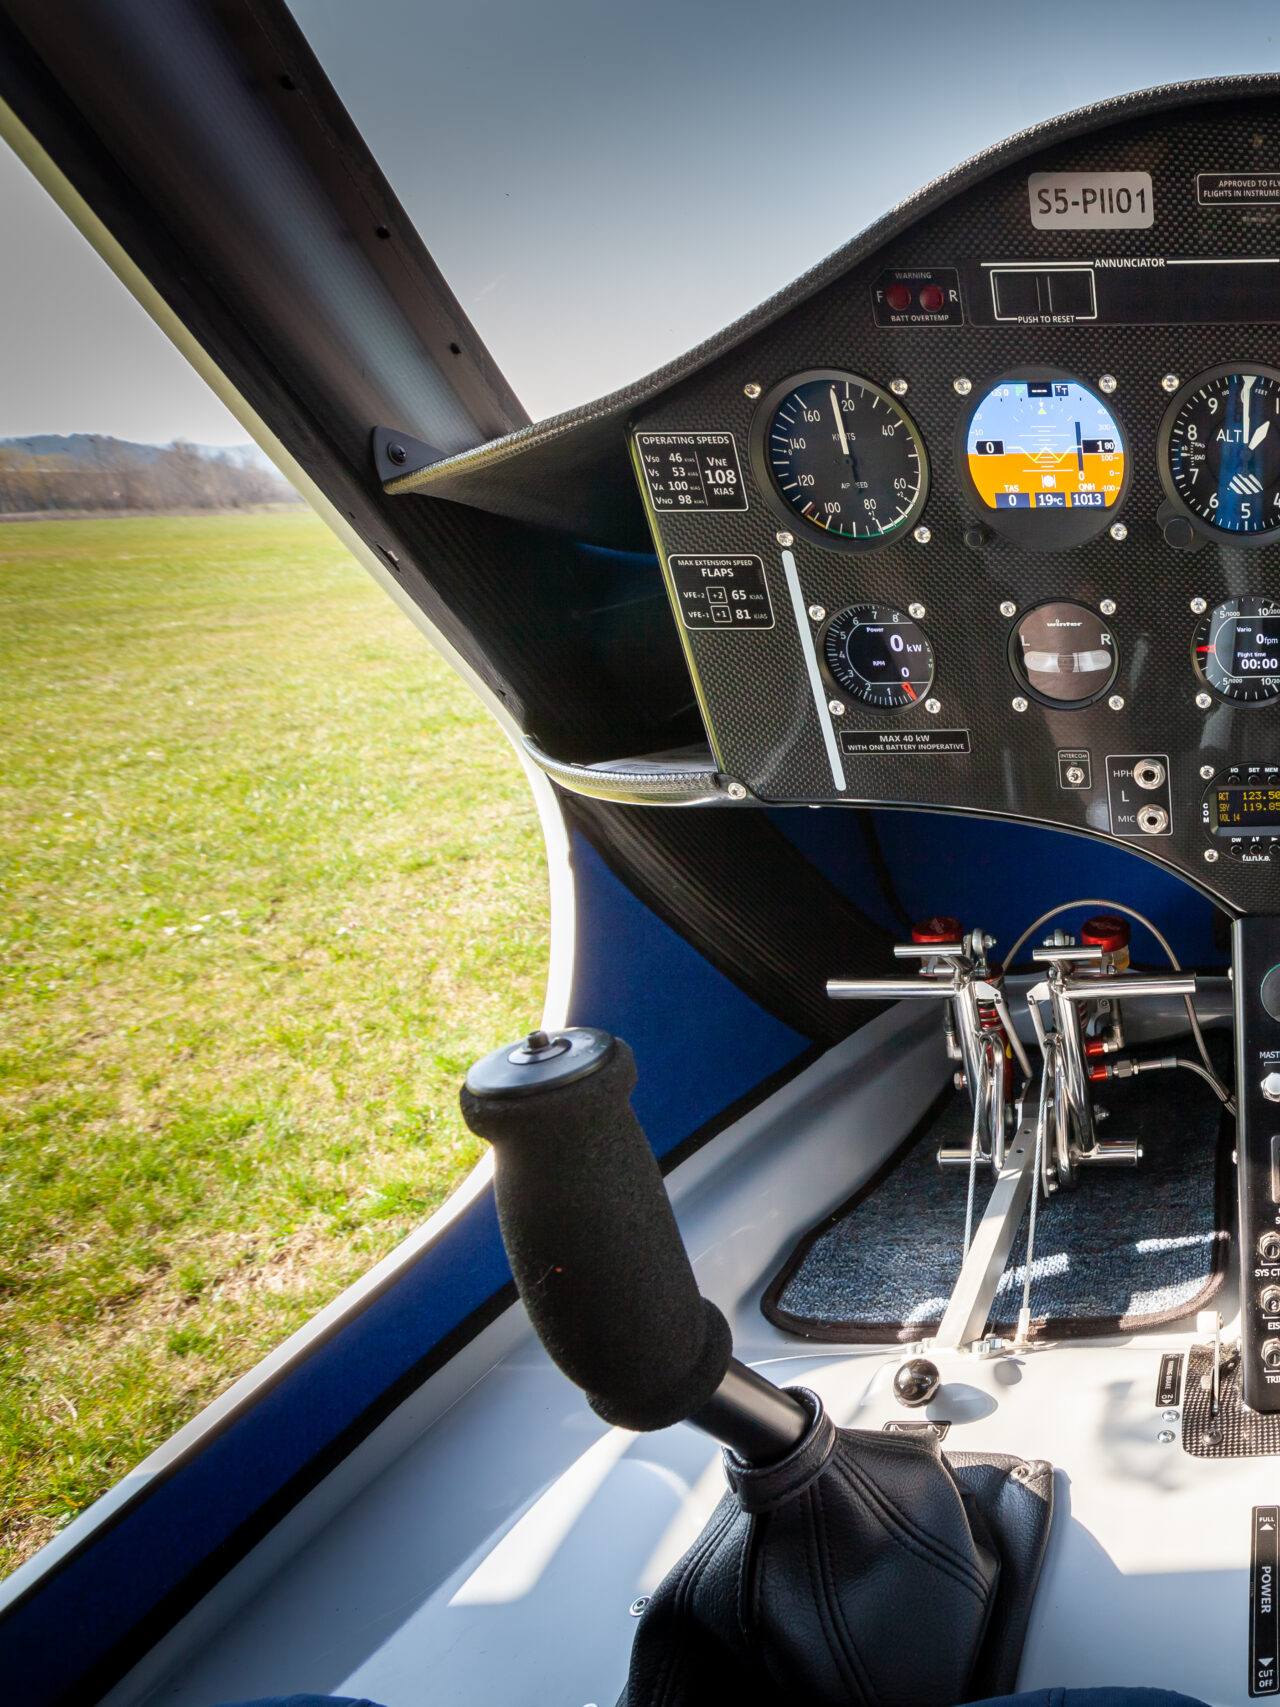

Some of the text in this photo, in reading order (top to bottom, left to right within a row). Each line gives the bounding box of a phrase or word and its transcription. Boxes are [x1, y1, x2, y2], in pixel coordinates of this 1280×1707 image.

[1218, 180, 1256, 188] APPROVED
[1258, 180, 1268, 188] TO
[1269, 180, 1280, 188] FLY
[1094, 258, 1165, 268] ANNUNCIATOR
[895, 271, 932, 280] WARNING
[1017, 315, 1075, 324] PUSH TO RESET
[842, 400, 855, 412] 20
[804, 411, 820, 422] 160
[882, 425, 894, 436] 40
[1216, 428, 1242, 442] ALT
[642, 436, 730, 444] OPERATING SPEEDS
[790, 438, 806, 450] 140
[986, 442, 995, 454] 0
[705, 470, 737, 484] 108
[798, 474, 814, 486] 120
[1078, 470, 1086, 482] 0
[894, 478, 906, 490] 60
[1004, 484, 1020, 492] TAS
[1078, 484, 1096, 492] QNH
[714, 488, 734, 496] KIAS
[864, 498, 877, 510] 80
[1008, 496, 1016, 506] 0
[1074, 494, 1102, 506] 1013
[824, 502, 841, 514] 100
[701, 568, 734, 578] FLAPS
[1220, 610, 1240, 619] 5/1000
[890, 634, 922, 652] 0 kW
[1022, 635, 1030, 646] L
[1101, 633, 1112, 646] R
[1242, 658, 1278, 670] 00:00
[1218, 792, 1229, 800] ACT
[1219, 804, 1230, 812] SBY
[1118, 814, 1136, 822] MIC
[1255, 1269, 1270, 1278] SYS
[1268, 1322, 1280, 1330] EIS
[1261, 1566, 1271, 1614] POWER
[1258, 1670, 1274, 1678] CUT
[1258, 1679, 1274, 1688] OFF
